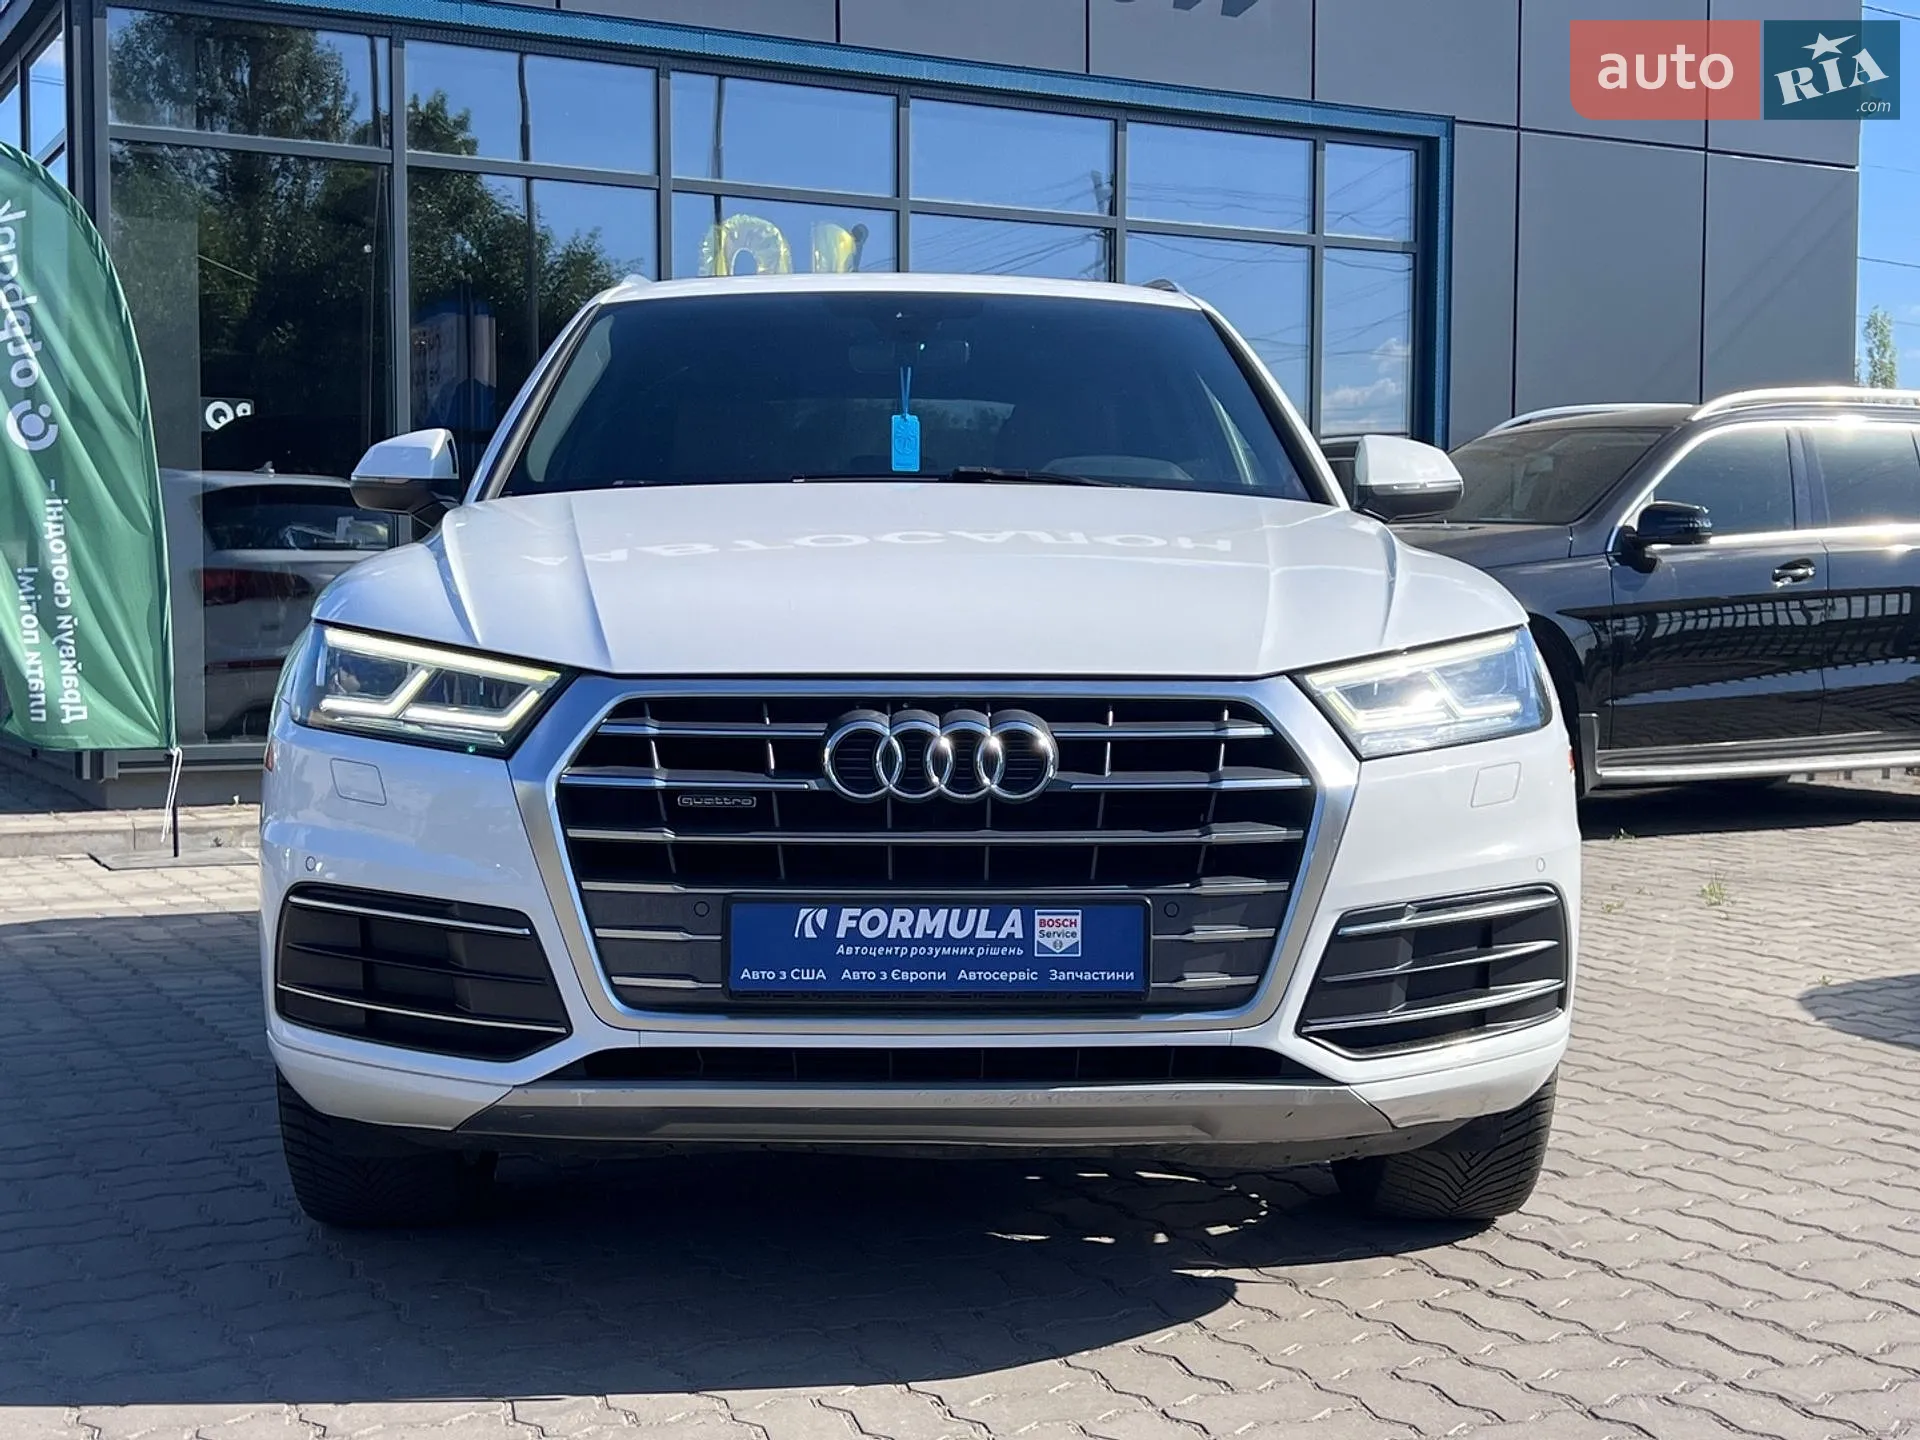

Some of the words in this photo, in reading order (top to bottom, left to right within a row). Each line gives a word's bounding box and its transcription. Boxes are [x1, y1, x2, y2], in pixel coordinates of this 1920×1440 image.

[681, 796, 753, 806] quattro
[836, 908, 1024, 939] FORMULA
[1039, 918, 1077, 928] BOSCH
[1038, 929, 1077, 939] Service
[836, 944, 908, 958] Автоцентр
[910, 945, 974, 958] розумних
[976, 944, 1024, 957] рішень
[740, 968, 775, 980] Авто
[790, 968, 827, 980] США
[841, 969, 876, 980] Авто
[891, 968, 947, 983] Європи
[957, 968, 1038, 983] Автосервіс
[1049, 969, 1135, 981] Запчастини
